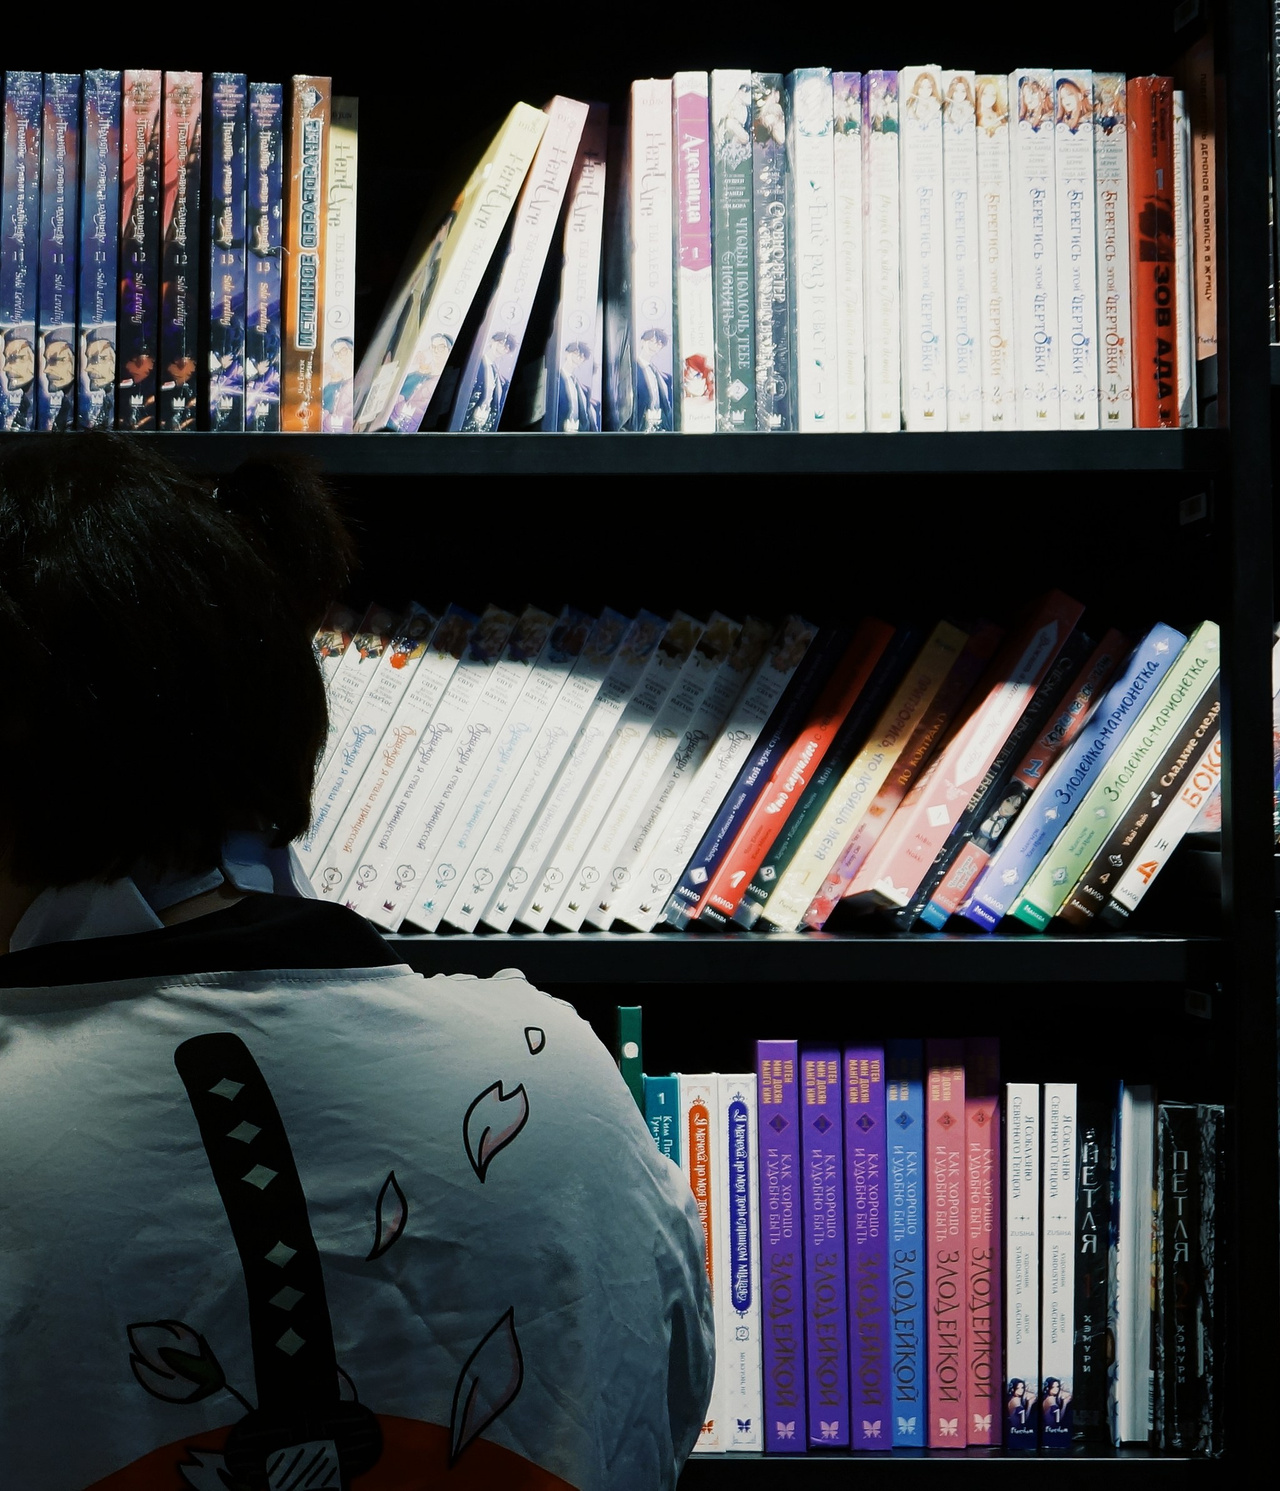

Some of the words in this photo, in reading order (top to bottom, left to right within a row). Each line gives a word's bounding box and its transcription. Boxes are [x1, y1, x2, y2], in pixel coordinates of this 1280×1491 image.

[1154, 264, 1172, 327] ЗОВ
[737, 334, 750, 370] ТЕБЕ
[1052, 656, 1162, 805] Злодейка-марионетка
[1101, 654, 1212, 803] Злодейка-марионетка
[744, 765, 762, 787] Мой
[1158, 735, 1200, 788] Сладкие
[1136, 859, 1159, 885] 4
[767, 1161, 780, 1211] УДОБНО
[781, 1153, 793, 1179] КАК
[893, 1158, 905, 1207] УДОБНО
[907, 1151, 918, 1175] КАК
[934, 1158, 948, 1208] УДОБНО
[949, 1151, 960, 1178] КАК
[781, 1185, 793, 1238] ХОРОШО
[907, 1182, 918, 1235] ХОРОШО
[949, 1182, 960, 1236] ХОРОШО
[1082, 1142, 1099, 1255] ПЕТЛЯ
[1172, 1150, 1190, 1262] ПЕТЛЯ
[768, 1213, 780, 1246] БЫТЬ
[894, 1210, 906, 1242] БЫТЬ
[936, 1211, 948, 1242] БЫТЬ
[891, 1249, 920, 1404] ЗЛОДЕЙКОЙ
[936, 1250, 962, 1404] ЗЛОДЕЙКОЙ
